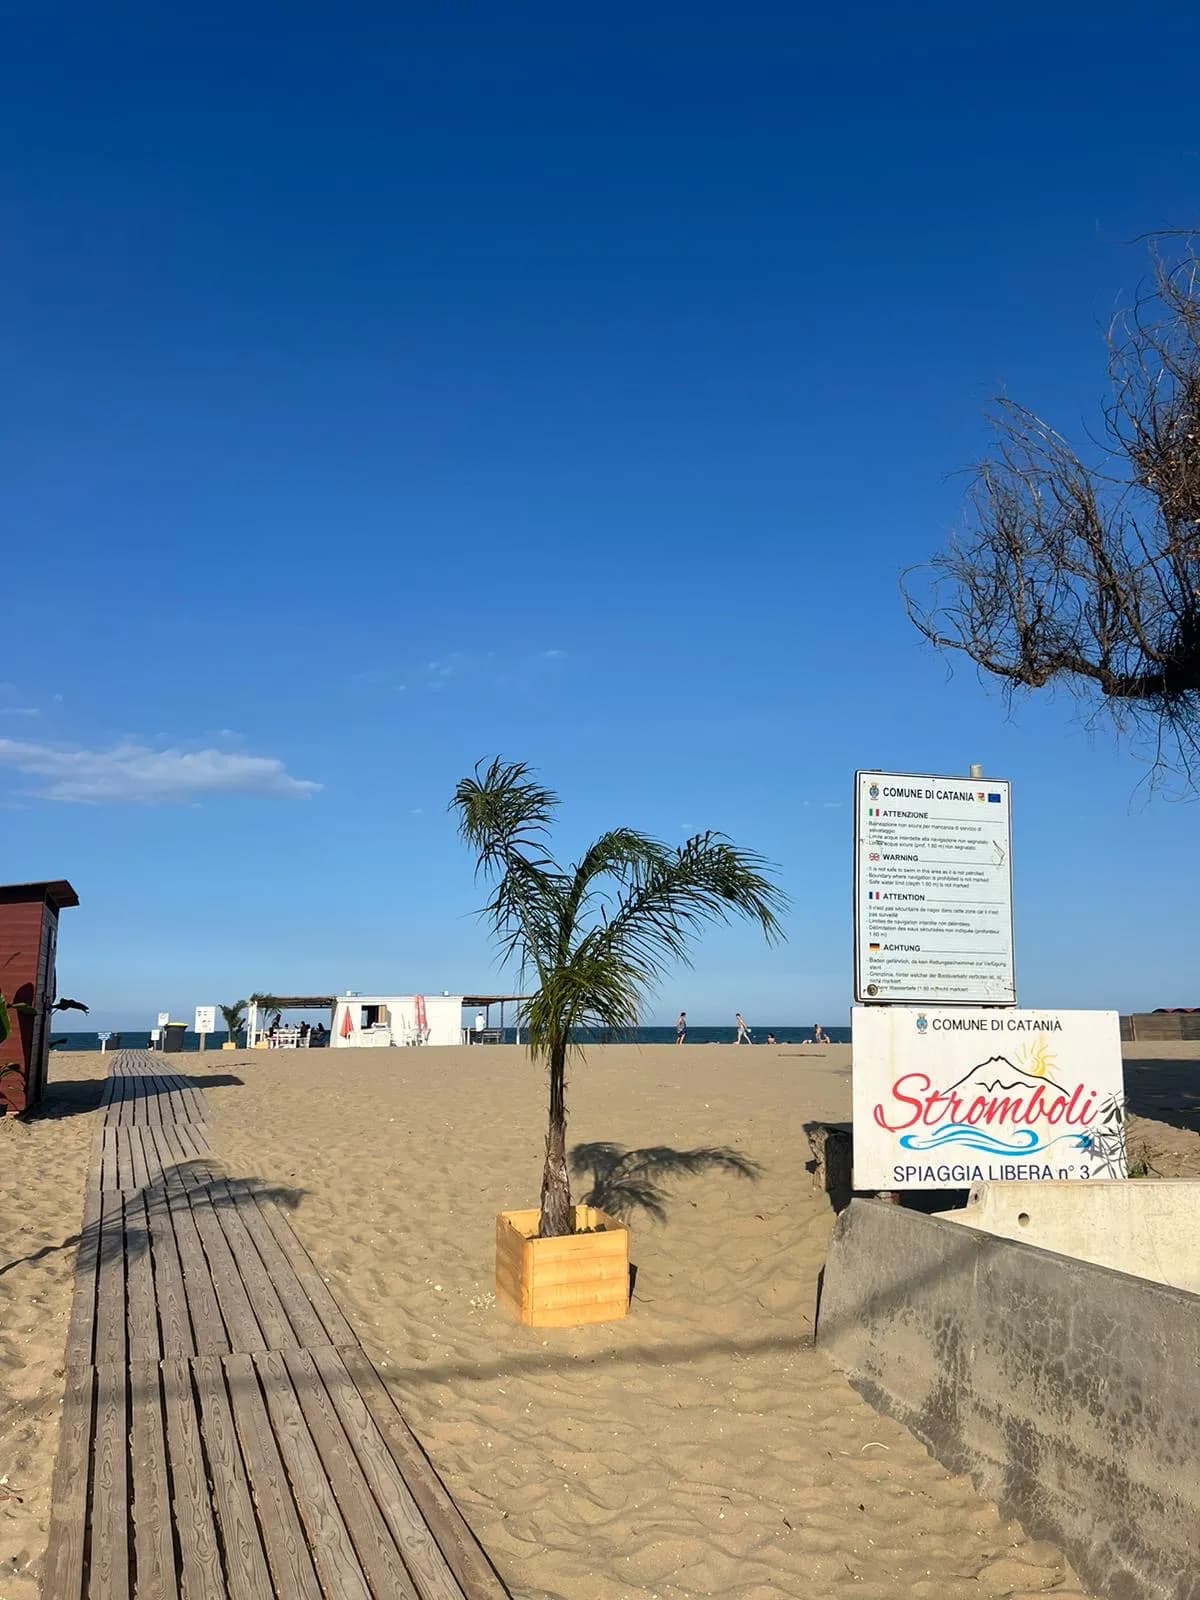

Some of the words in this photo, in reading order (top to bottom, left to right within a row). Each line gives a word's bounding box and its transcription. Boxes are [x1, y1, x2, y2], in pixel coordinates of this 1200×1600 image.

[883, 787, 923, 799] COMUNE
[925, 791, 934, 800] DI
[936, 791, 975, 802] CATANIA
[883, 810, 929, 819] ATTENZIONE
[883, 854, 919, 862] WARNING
[883, 893, 925, 902] ATTENTION
[883, 944, 921, 952] ACHTUNG
[932, 1018, 988, 1032] COMUNE
[991, 1018, 1004, 1032] DI
[1006, 1020, 1063, 1032] CATANIA
[873, 1072, 1099, 1132] Stromboli
[893, 1164, 984, 1182] SPIAGGIA
[988, 1165, 1054, 1181] LIBERA
[1080, 1165, 1090, 1180] 3
